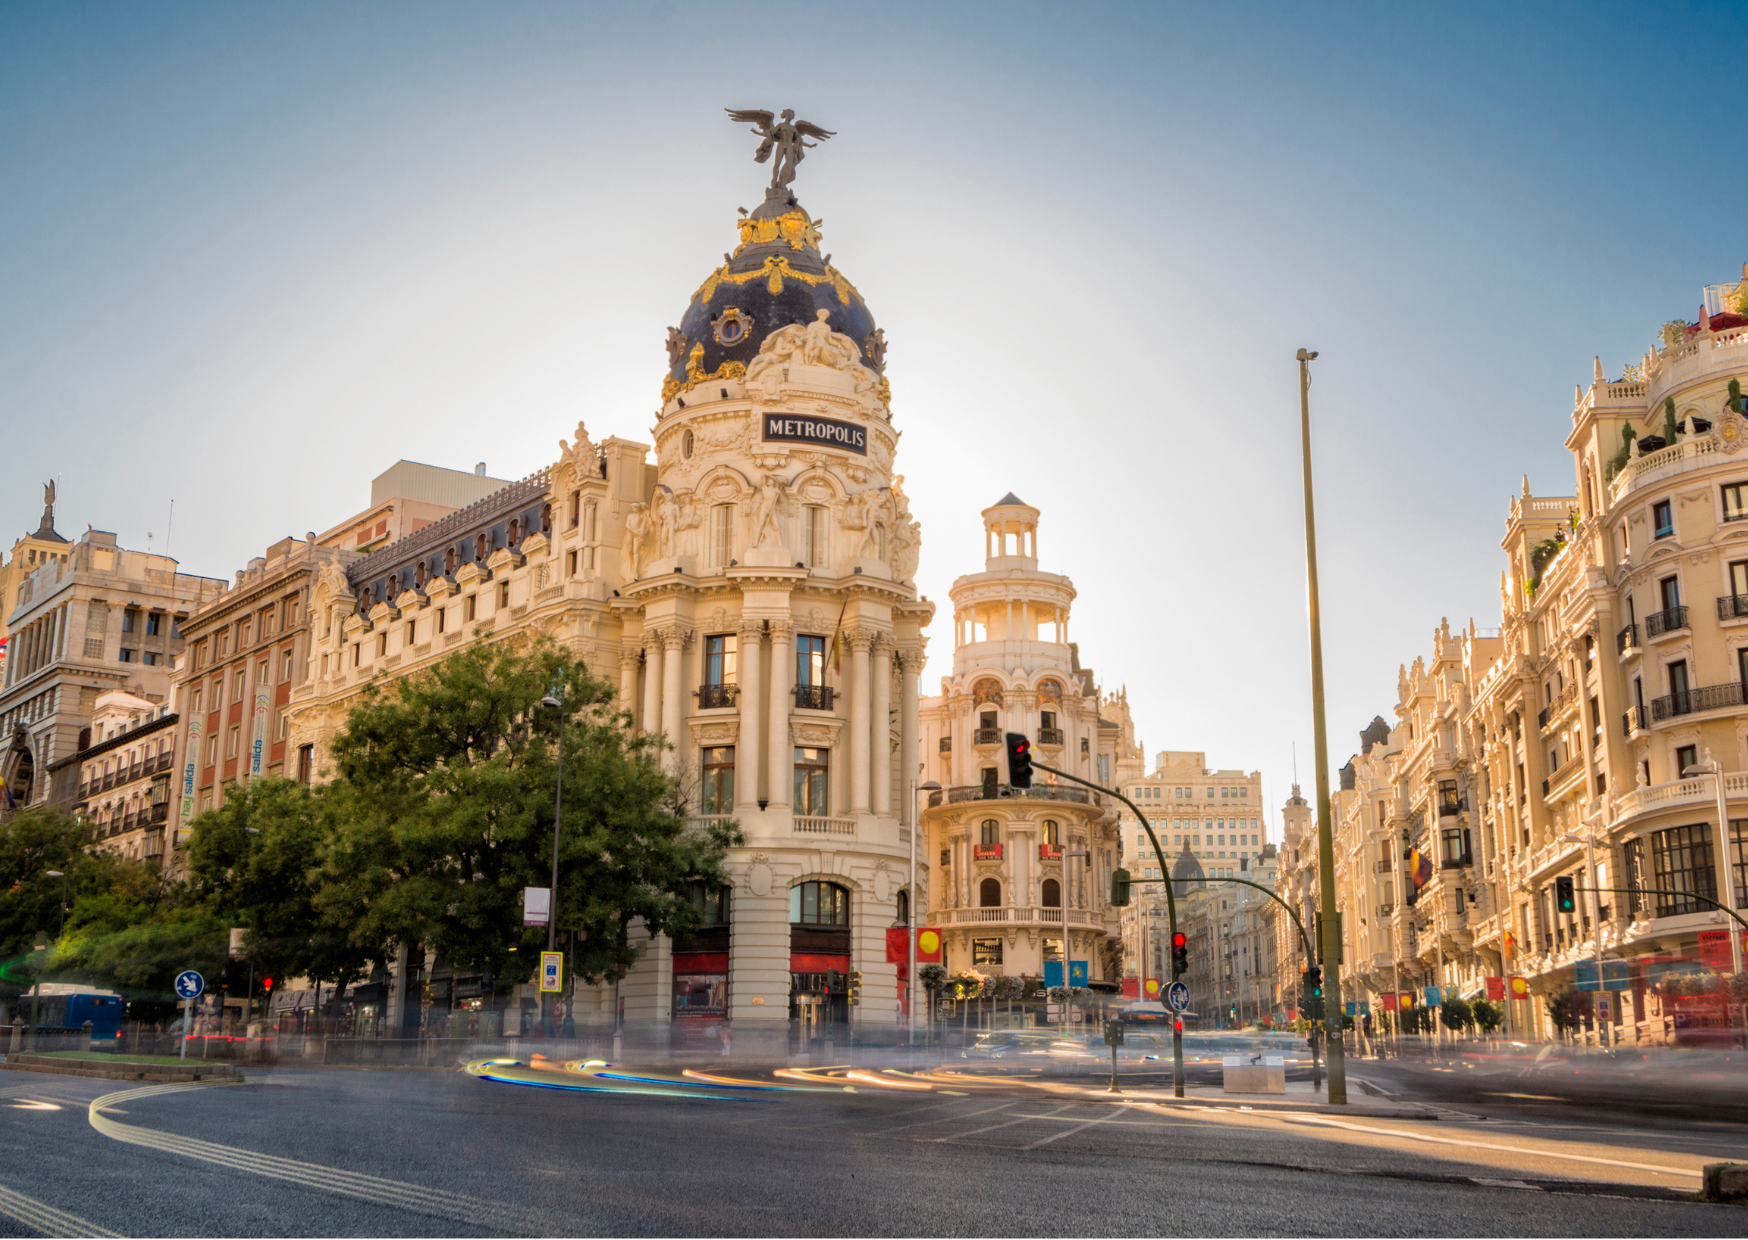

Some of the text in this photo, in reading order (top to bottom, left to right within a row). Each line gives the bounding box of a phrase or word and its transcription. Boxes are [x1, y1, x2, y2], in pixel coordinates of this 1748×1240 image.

[769, 419, 864, 447] METROPOLIS
[252, 739, 263, 773] salida
[184, 763, 195, 795] salida
[180, 796, 195, 817] hay
